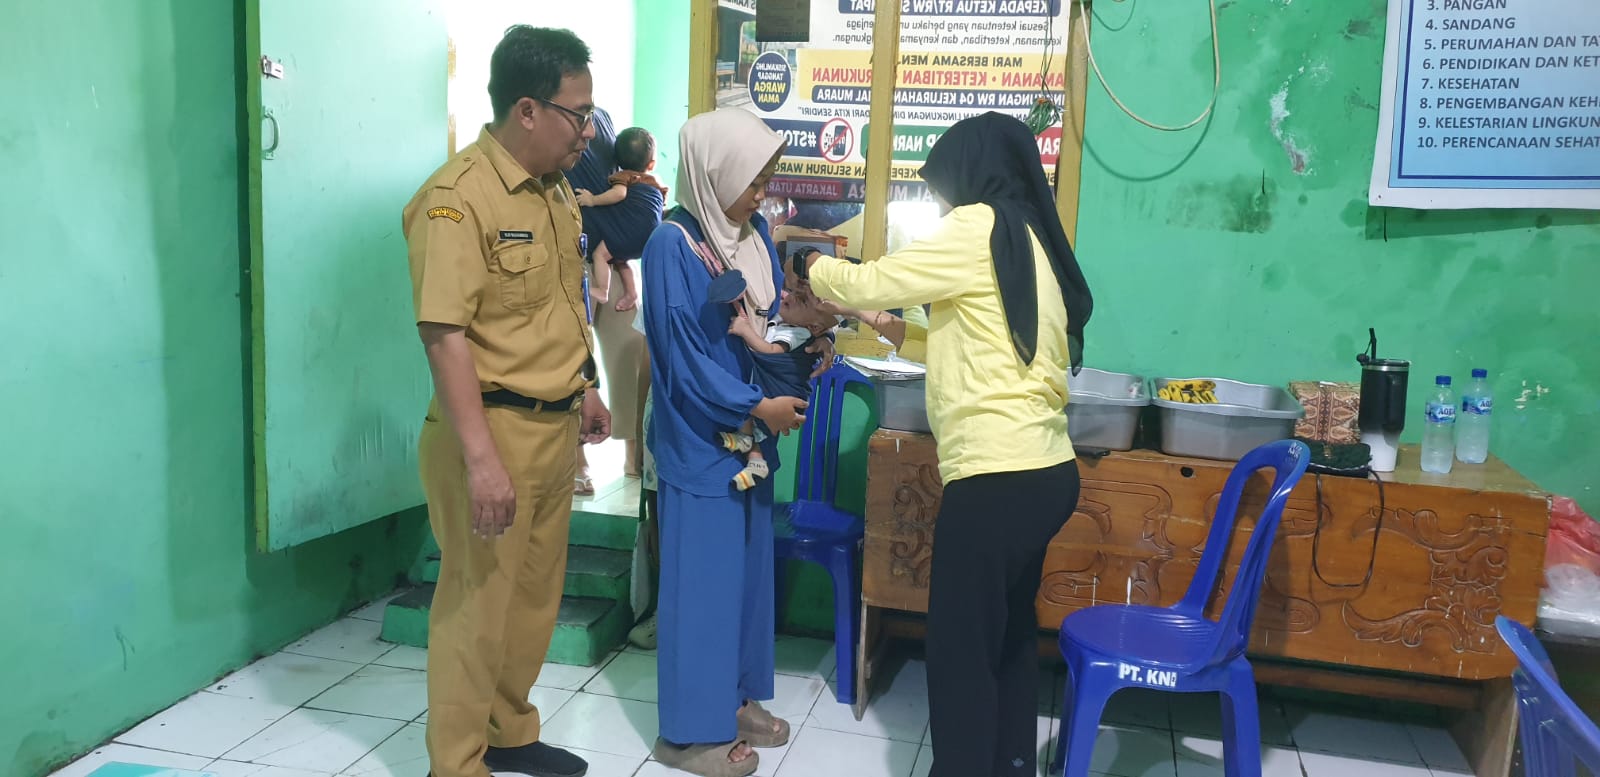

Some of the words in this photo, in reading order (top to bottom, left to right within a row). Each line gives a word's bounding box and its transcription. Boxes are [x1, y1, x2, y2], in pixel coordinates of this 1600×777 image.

[1444, 0, 1507, 11] PANGAN
[1425, 19, 1438, 30] 4.
[1442, 17, 1516, 30] SANDANG
[1424, 39, 1436, 50] 5.
[1441, 36, 1539, 50] PERUMAHAN
[1543, 35, 1576, 48] DAN
[1581, 35, 1600, 47] TA
[1422, 59, 1435, 70] 6.
[1439, 57, 1531, 70] PENDIDIKAN
[1535, 56, 1569, 68] DAN
[1421, 78, 1433, 89] 7.
[1438, 77, 1520, 89] KESEHATAN
[1420, 98, 1432, 109] 8.
[1437, 96, 1564, 109] PENGEMBANGAN
[1569, 96, 1600, 108] KEH
[1418, 117, 1431, 128] 9.
[1435, 117, 1528, 128] KELESTARIAN
[1417, 137, 1437, 148] 10.
[1442, 136, 1551, 148] PERENCANAAN
[1555, 136, 1600, 148] SEHAT
[1118, 662, 1143, 682] PT.
